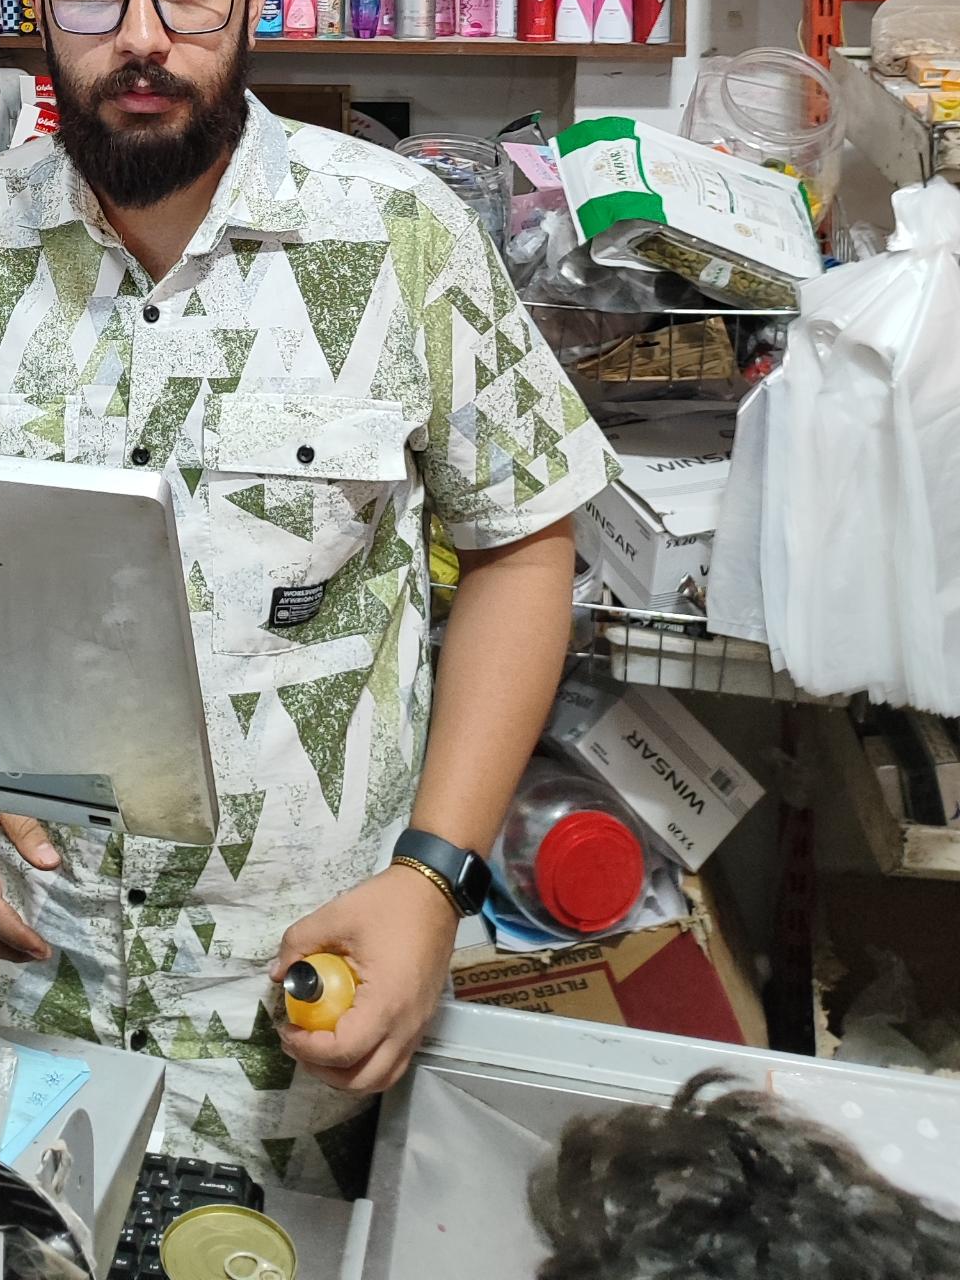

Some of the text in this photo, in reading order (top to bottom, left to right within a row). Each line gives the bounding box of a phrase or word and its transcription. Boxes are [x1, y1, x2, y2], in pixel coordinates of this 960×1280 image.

[615, 149, 624, 183] AKBAR
[626, 728, 707, 817] WINSAR
[533, 977, 589, 998] FILTER
